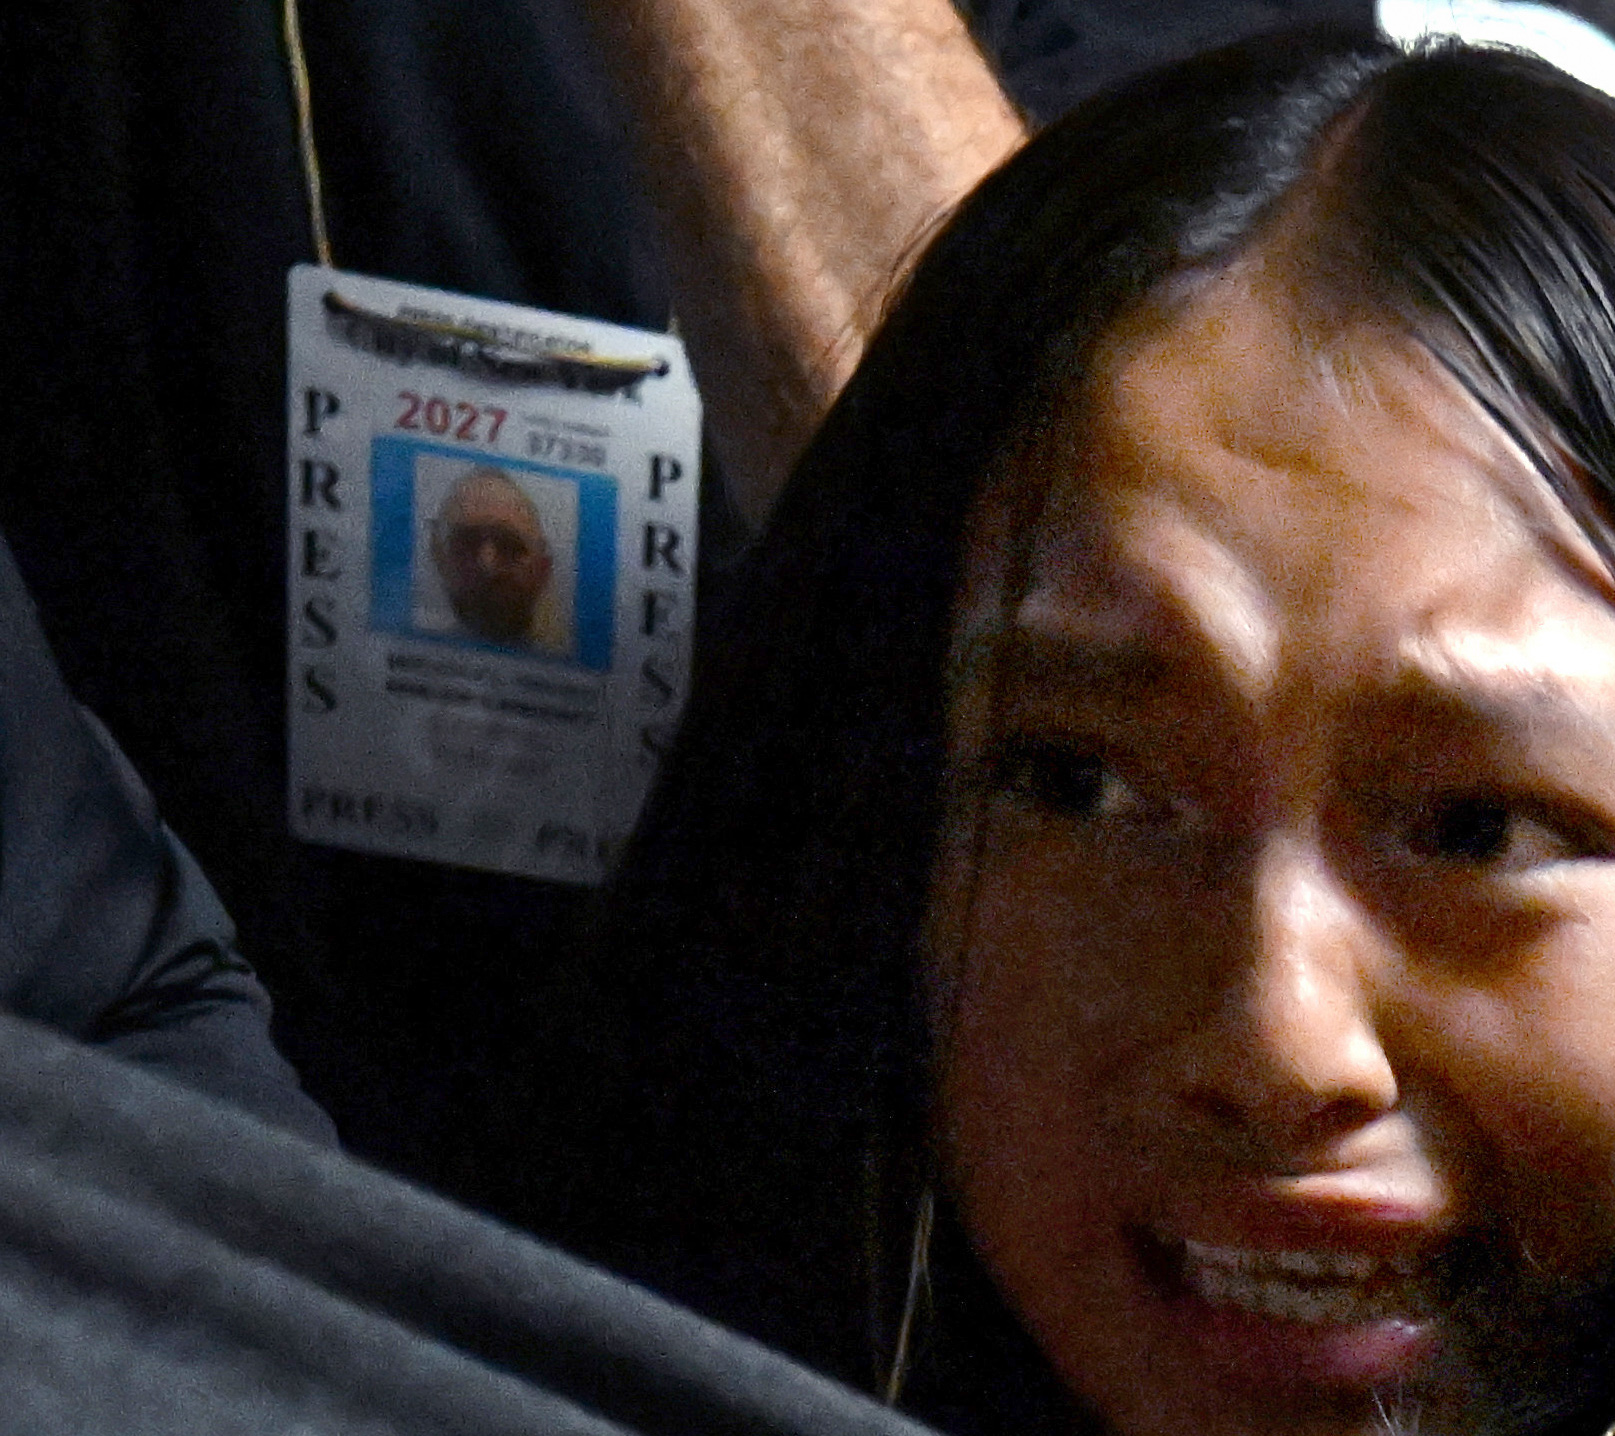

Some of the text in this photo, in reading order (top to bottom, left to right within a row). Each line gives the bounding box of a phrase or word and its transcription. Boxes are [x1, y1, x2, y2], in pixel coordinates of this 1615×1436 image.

[301, 390, 341, 713] PRESS
[396, 391, 509, 444] 2027
[641, 454, 684, 772] PRESS
